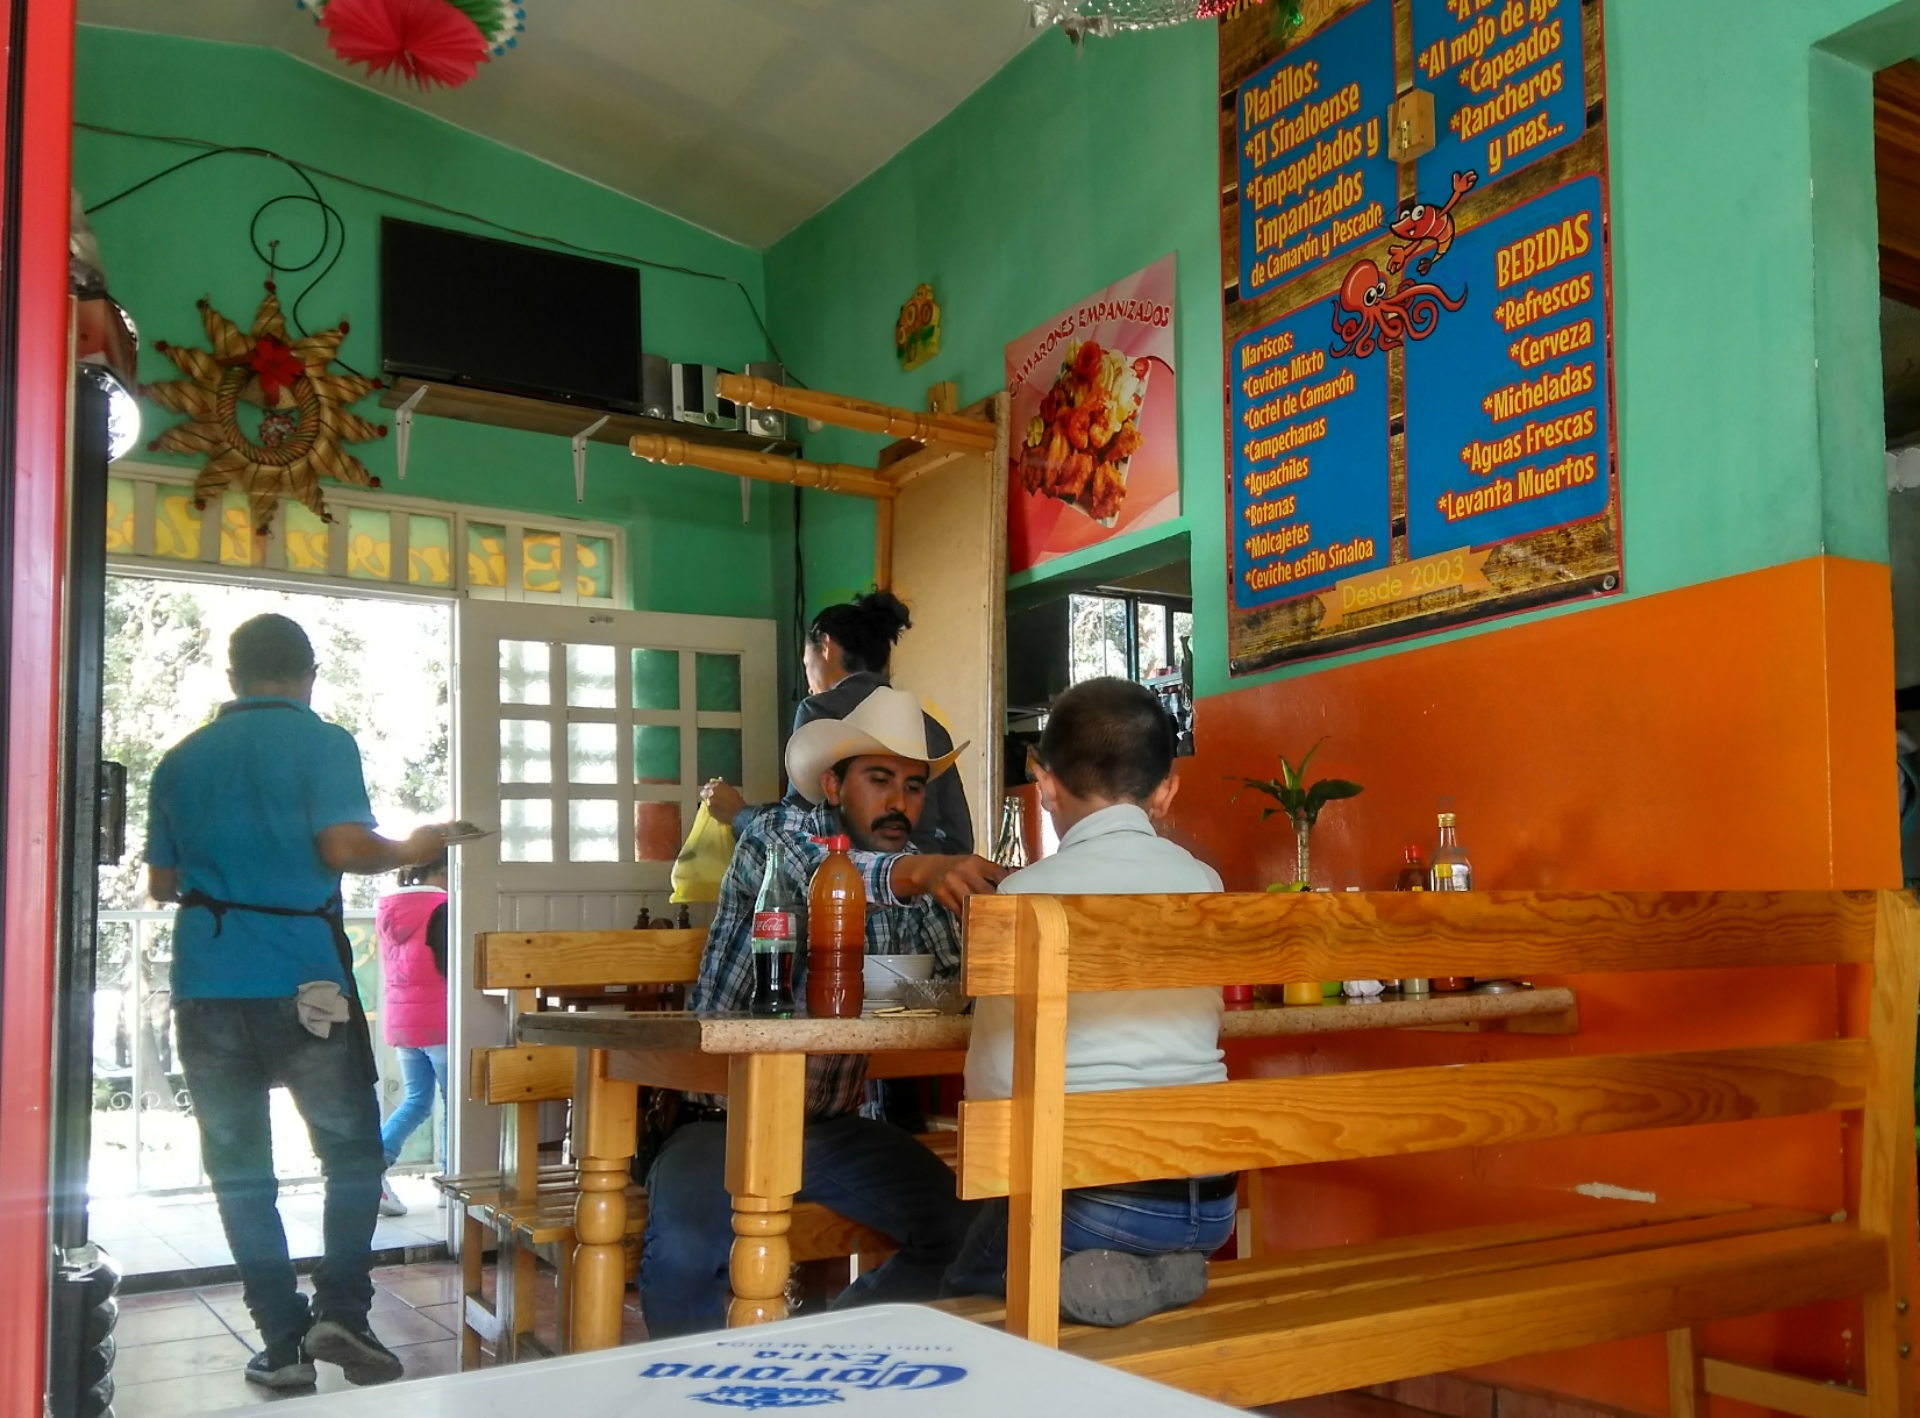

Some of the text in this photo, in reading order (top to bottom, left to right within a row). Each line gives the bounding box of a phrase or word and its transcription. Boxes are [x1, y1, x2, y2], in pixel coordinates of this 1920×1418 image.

[1450, 16, 1495, 63] mojo
[1500, 1, 1524, 35] de
[1243, 61, 1319, 131] Platillos:
[1270, 83, 1360, 158] Sinaloense
[1366, 118, 1379, 157] y
[1488, 113, 1563, 174] y mas...
[1254, 171, 1363, 253] Empanizados
[1251, 203, 1383, 287] de Camarón y Pescado
[1498, 213, 1589, 288] BEBIDAS
[1009, 299, 1171, 398] CAMARONES EMPANIZADOS
[1242, 332, 1294, 369] Mariscos:
[1291, 351, 1325, 380] Mixto
[1283, 395, 1298, 417] de
[1299, 373, 1355, 411] Camarón
[1526, 410, 1593, 454] Frescas
[1518, 455, 1595, 500] Muertos
[1294, 549, 1327, 580] estilo
[1329, 538, 1374, 569] Sinaloa
[1342, 553, 1465, 609] Desde 2003
[715, 1341, 809, 1350] MEDIDA
[753, 1350, 891, 1366] Extra
[638, 1361, 968, 1391] Corona
